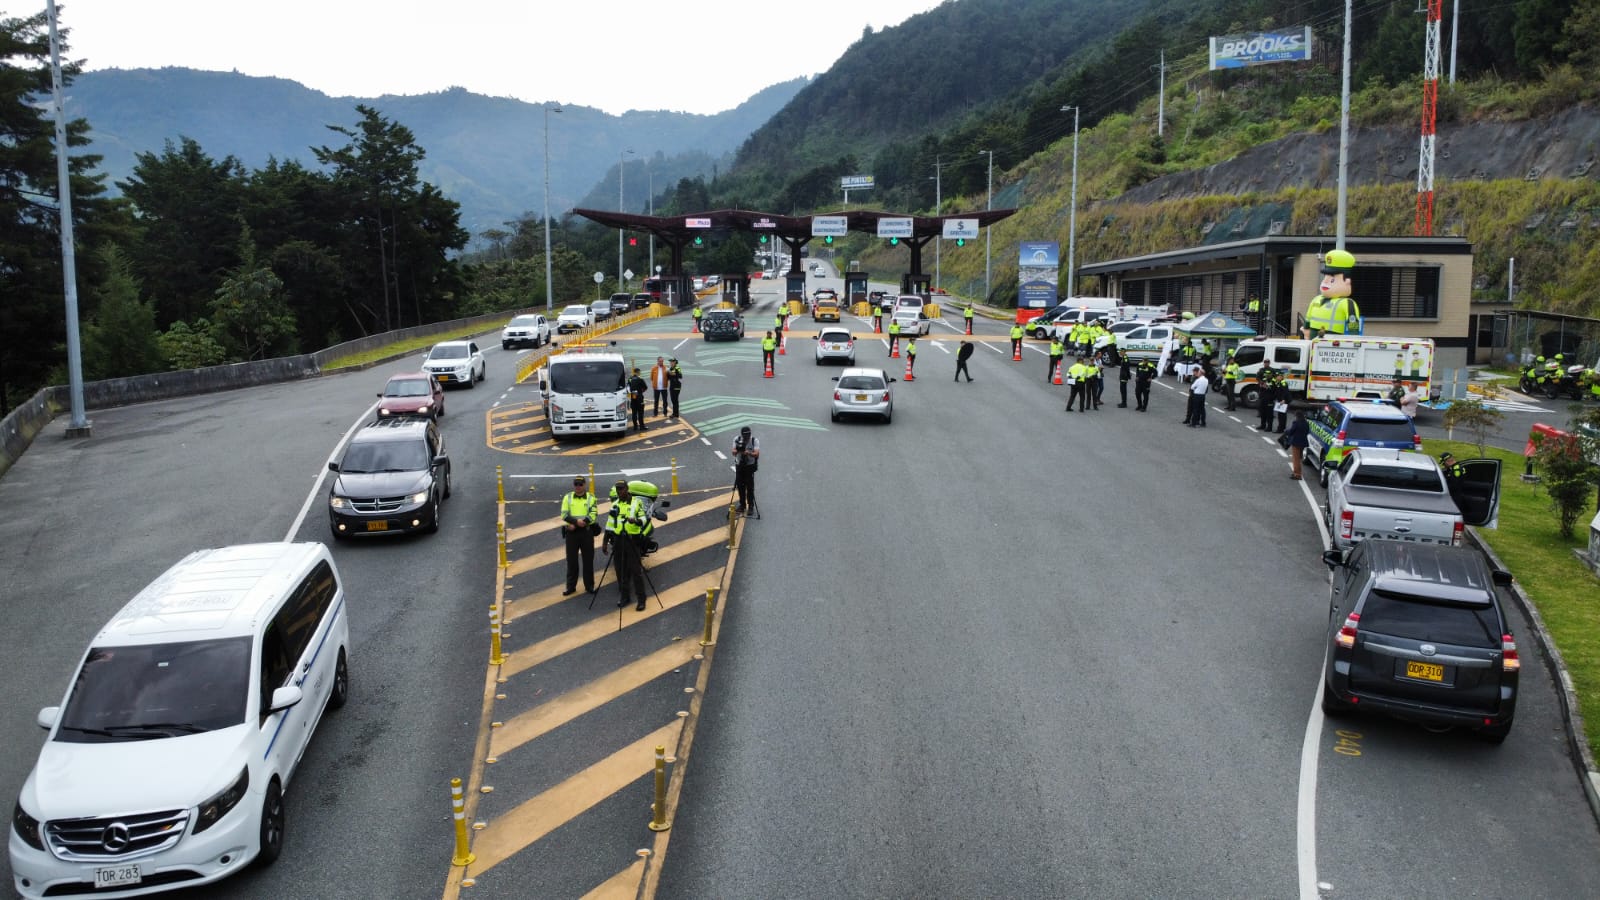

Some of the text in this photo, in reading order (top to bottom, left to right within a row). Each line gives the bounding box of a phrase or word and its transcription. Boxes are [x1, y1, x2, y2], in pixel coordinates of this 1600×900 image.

[1221, 34, 1302, 57] BROOKS
[1426, 666, 1442, 677] 310
[95, 867, 139, 882] TOR 283
